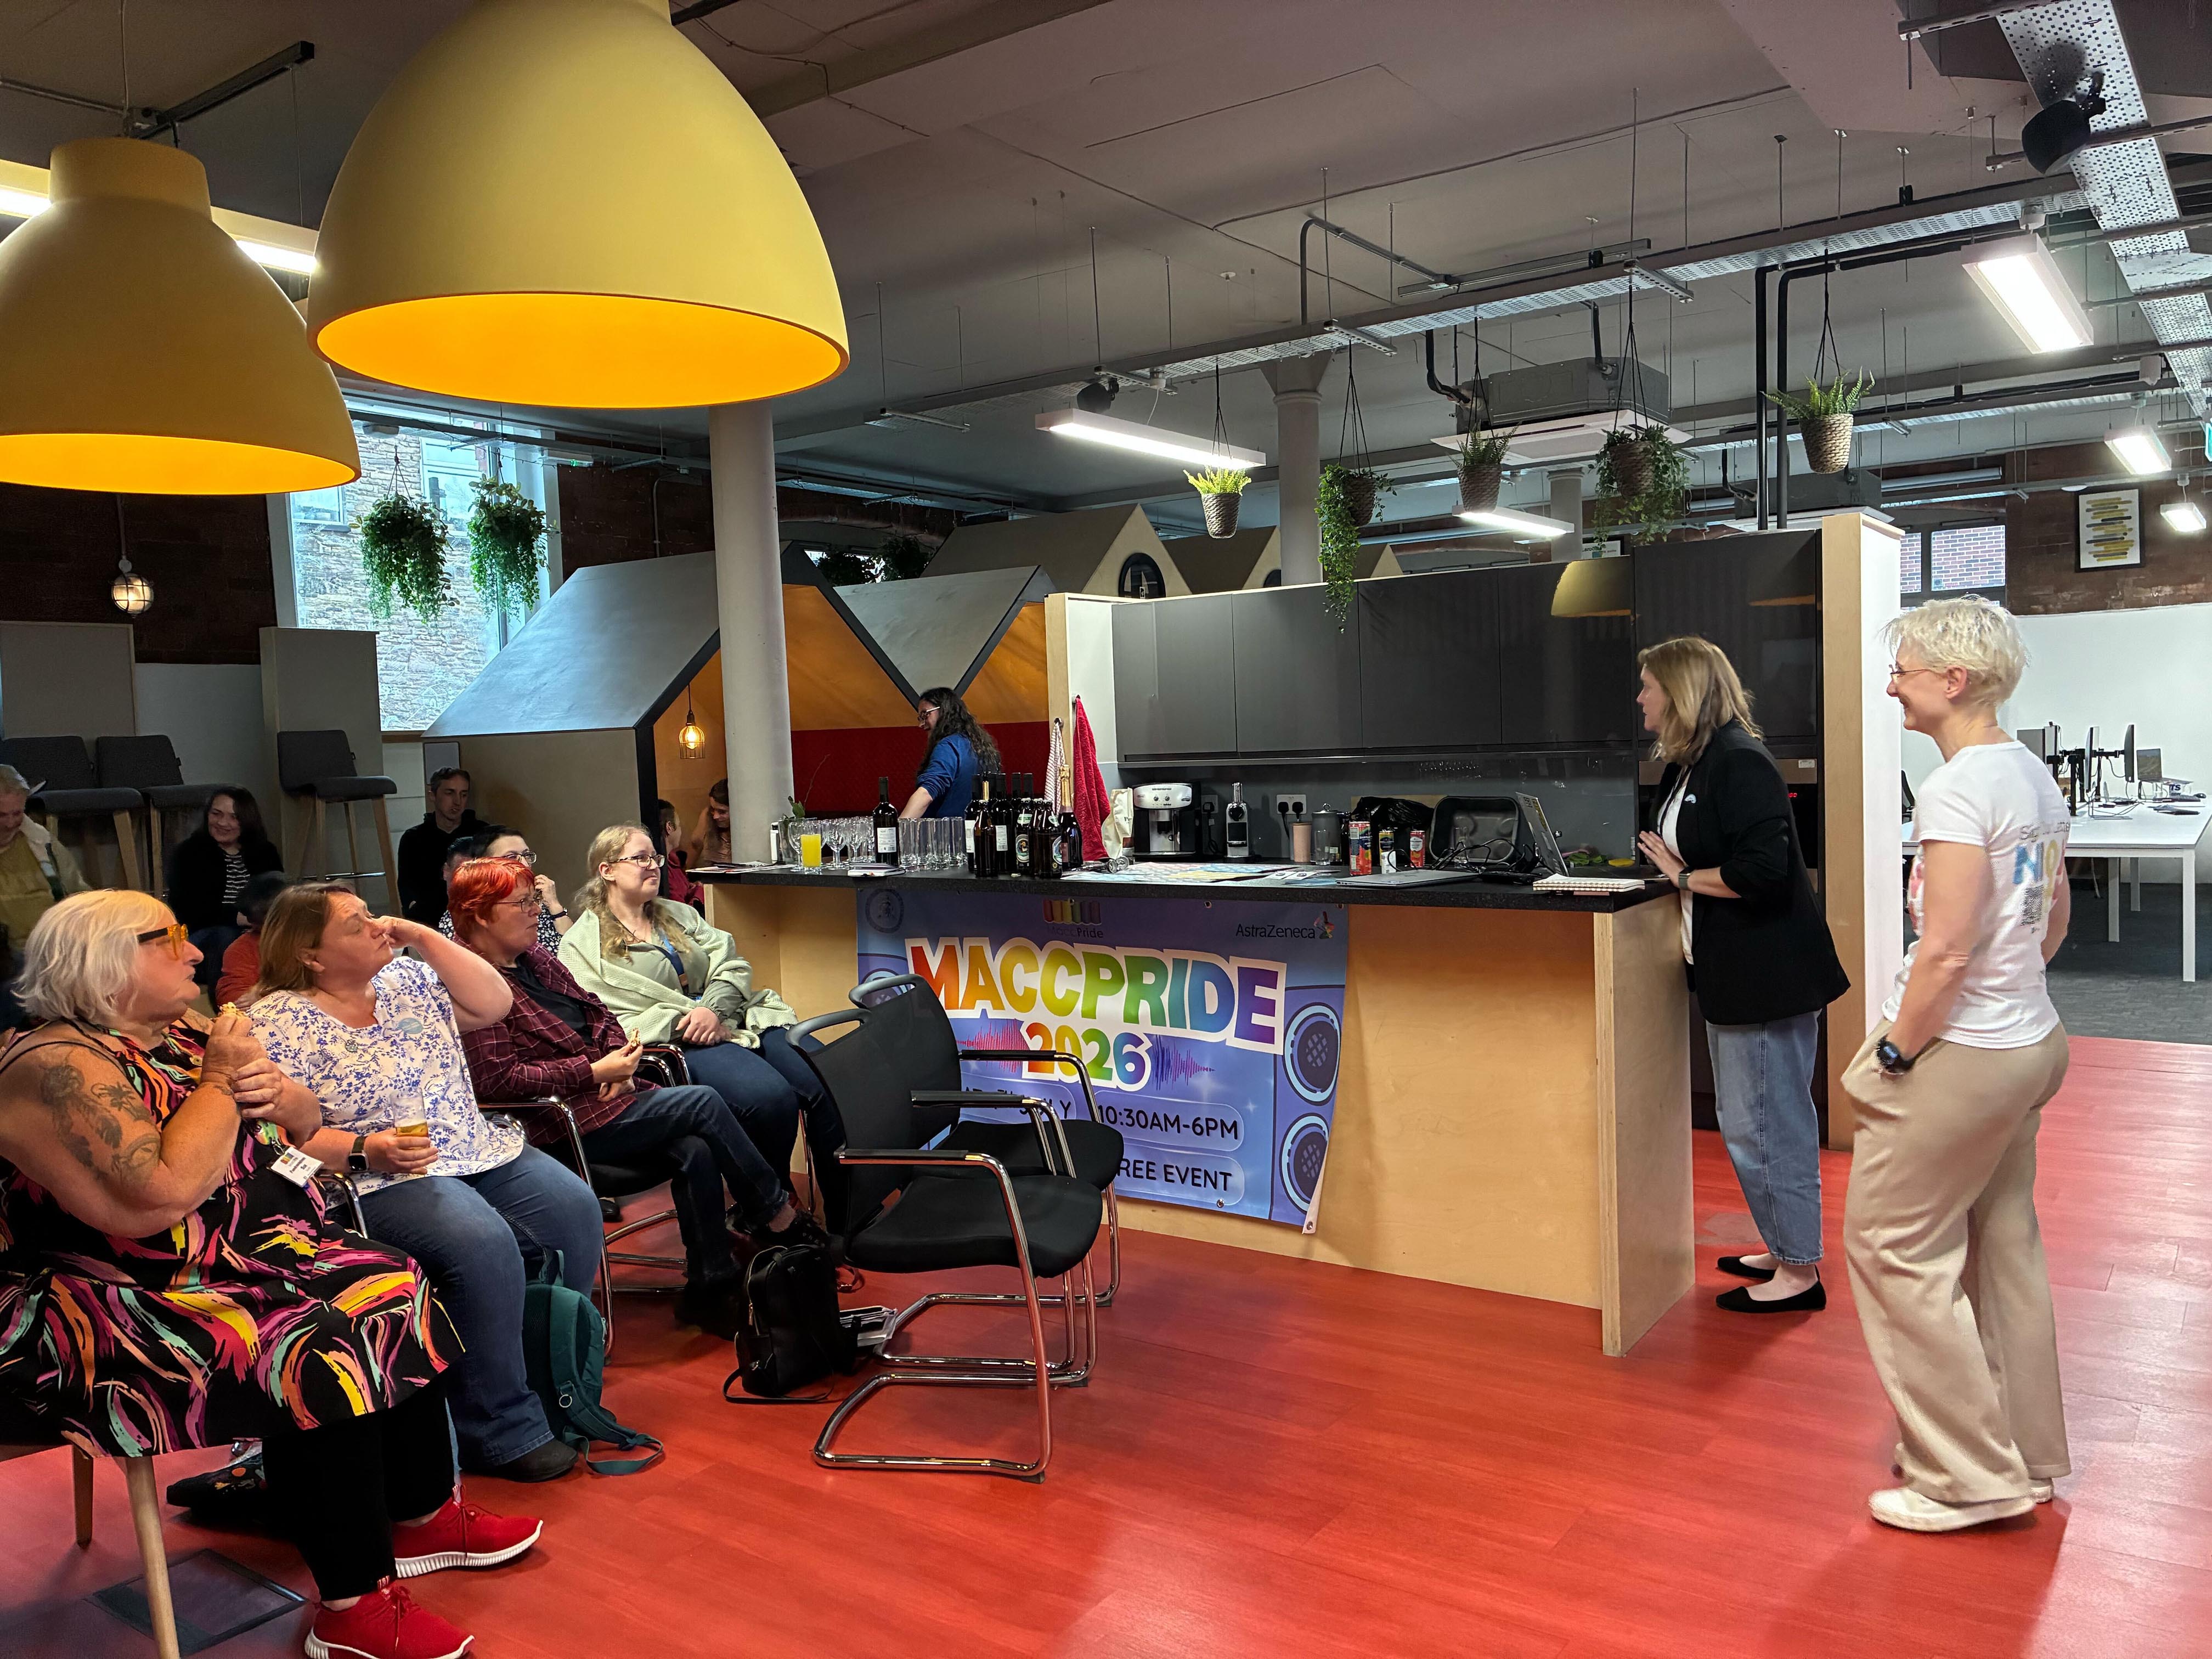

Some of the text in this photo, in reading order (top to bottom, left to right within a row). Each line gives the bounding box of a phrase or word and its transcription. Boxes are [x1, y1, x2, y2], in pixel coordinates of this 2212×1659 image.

[1235, 923, 1316, 939] AstraZeneca
[910, 944, 1280, 1046] MACCPRIDE
[1025, 1022, 1147, 1085] 2026
[1098, 1105, 1238, 1140] 10:30AM-6PM
[1117, 1158, 1233, 1192] REE EVENT
